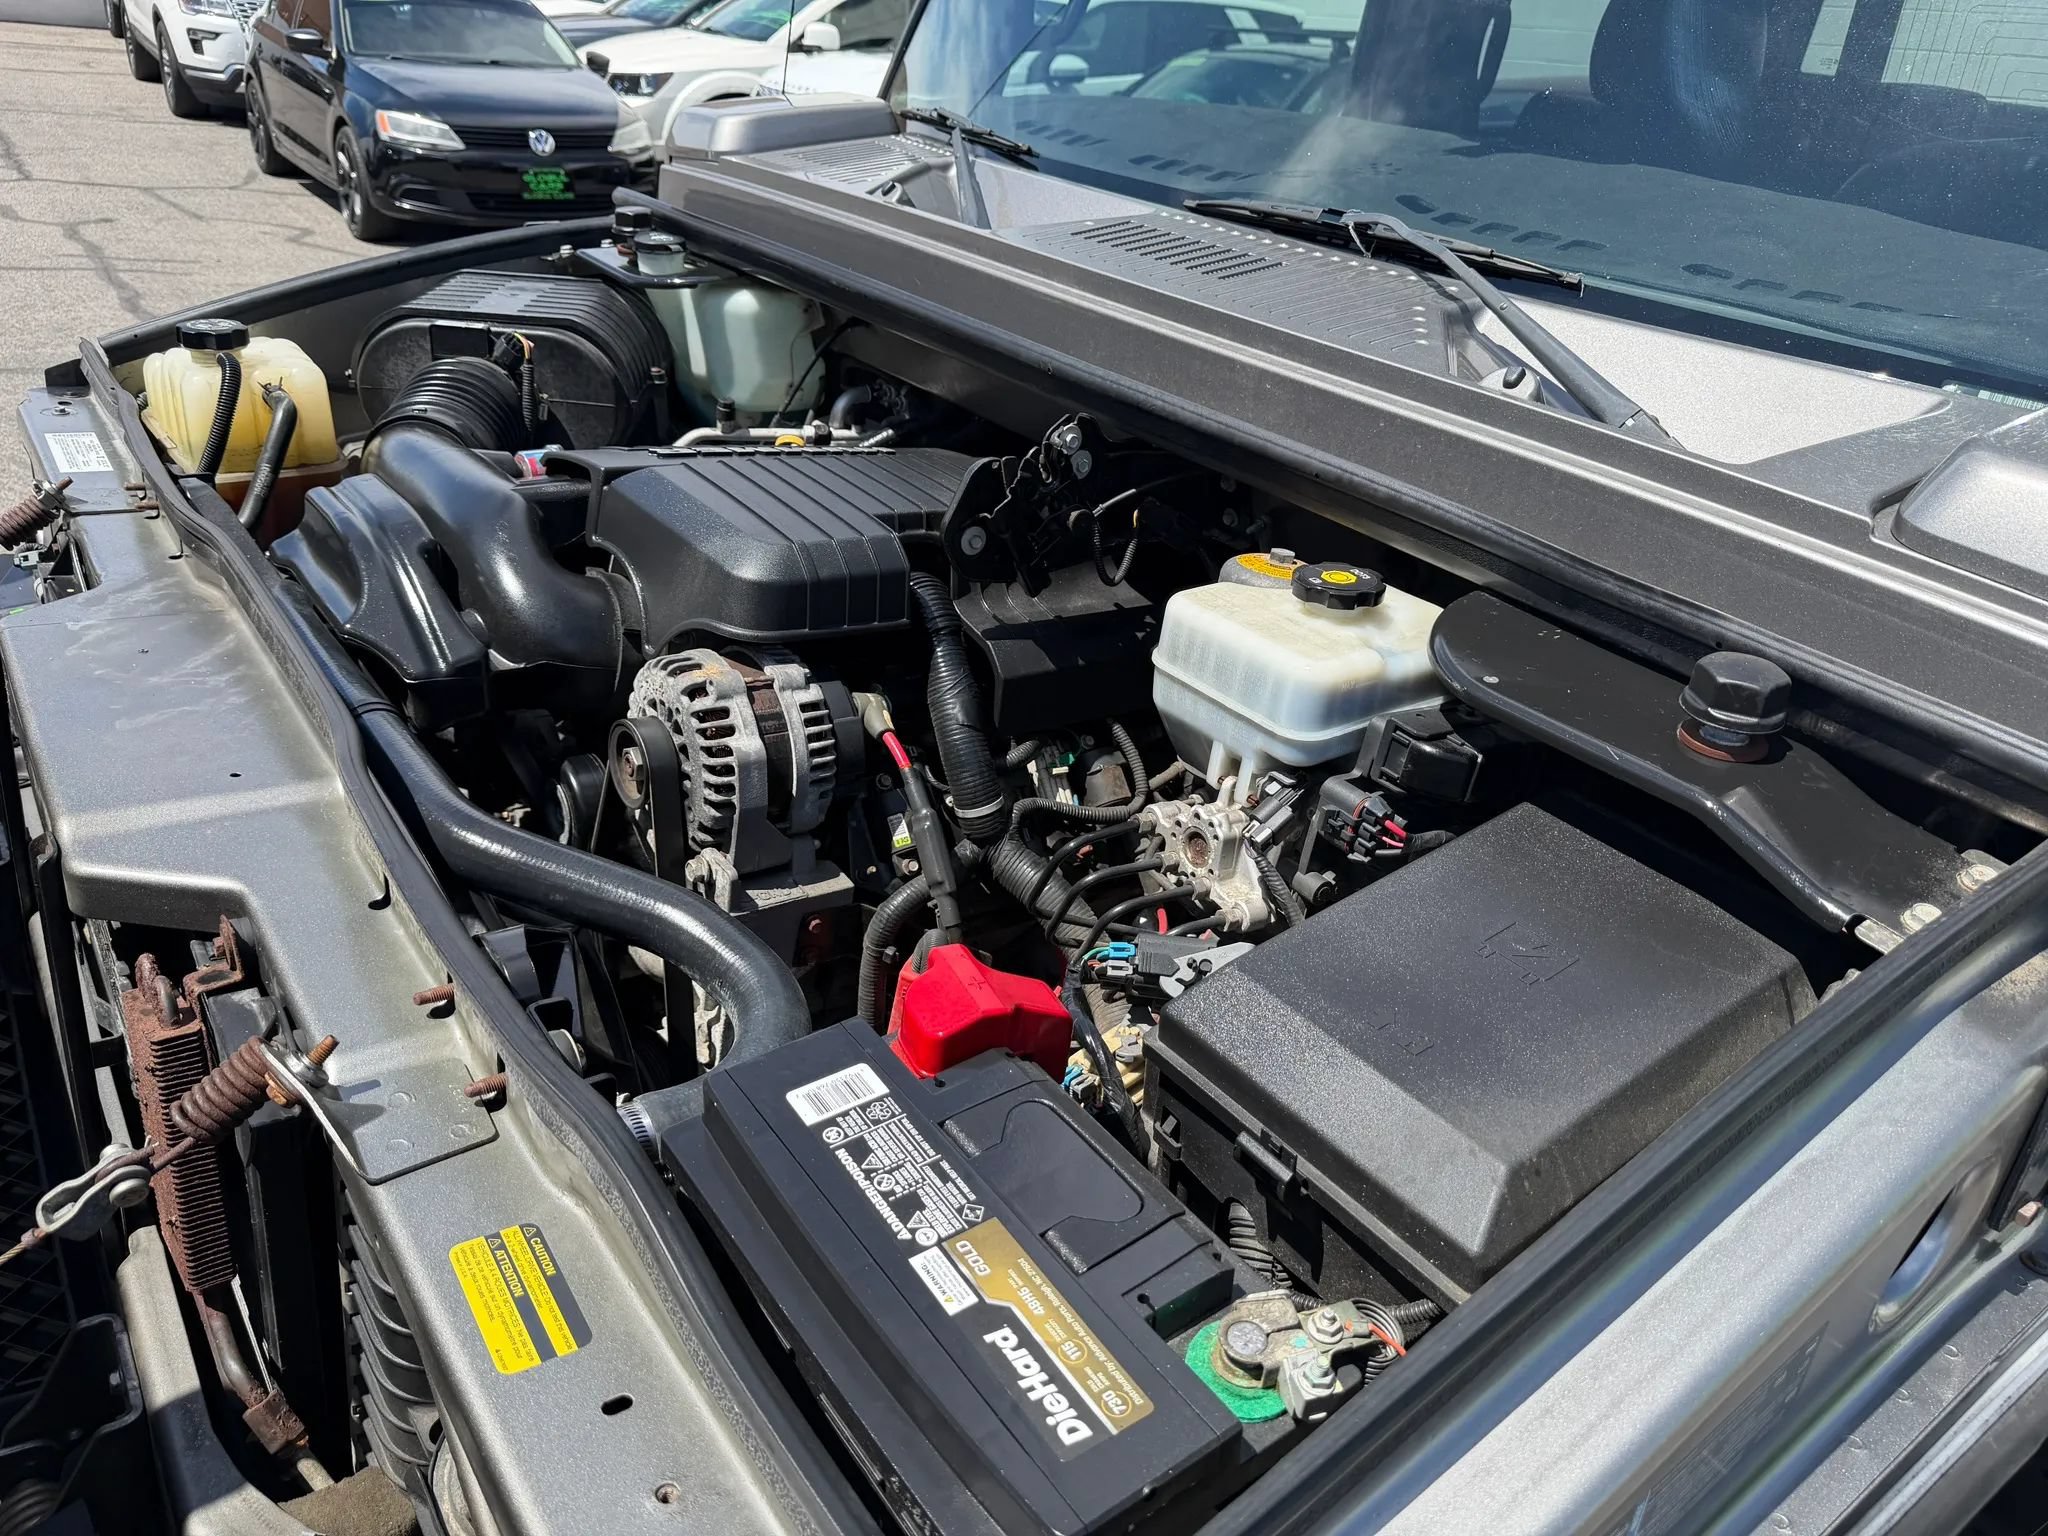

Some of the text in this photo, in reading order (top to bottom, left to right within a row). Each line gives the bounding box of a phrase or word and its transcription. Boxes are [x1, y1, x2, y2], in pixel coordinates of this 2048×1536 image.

[832, 1146, 906, 1232] DANGER/POISON
[516, 1239, 529, 1256] WHEEL
[529, 1236, 556, 1276] CAUTION
[955, 1240, 992, 1276] GOLD
[493, 1248, 524, 1297] ATTENTION
[524, 1256, 537, 1274] DRIVE
[492, 1276, 507, 1297] ROUES
[919, 1262, 947, 1296] WARNING:
[1031, 1274, 1043, 1285] NC
[543, 1296, 552, 1305] Do
[547, 1304, 555, 1313] not
[1070, 1320, 1087, 1337] Auto
[1082, 1335, 1107, 1362] Advance
[1103, 1359, 1116, 1371] by:
[982, 1326, 1094, 1447] DieHard
[1110, 1369, 1144, 1405] Distributed
[1100, 1388, 1128, 1415] 730
